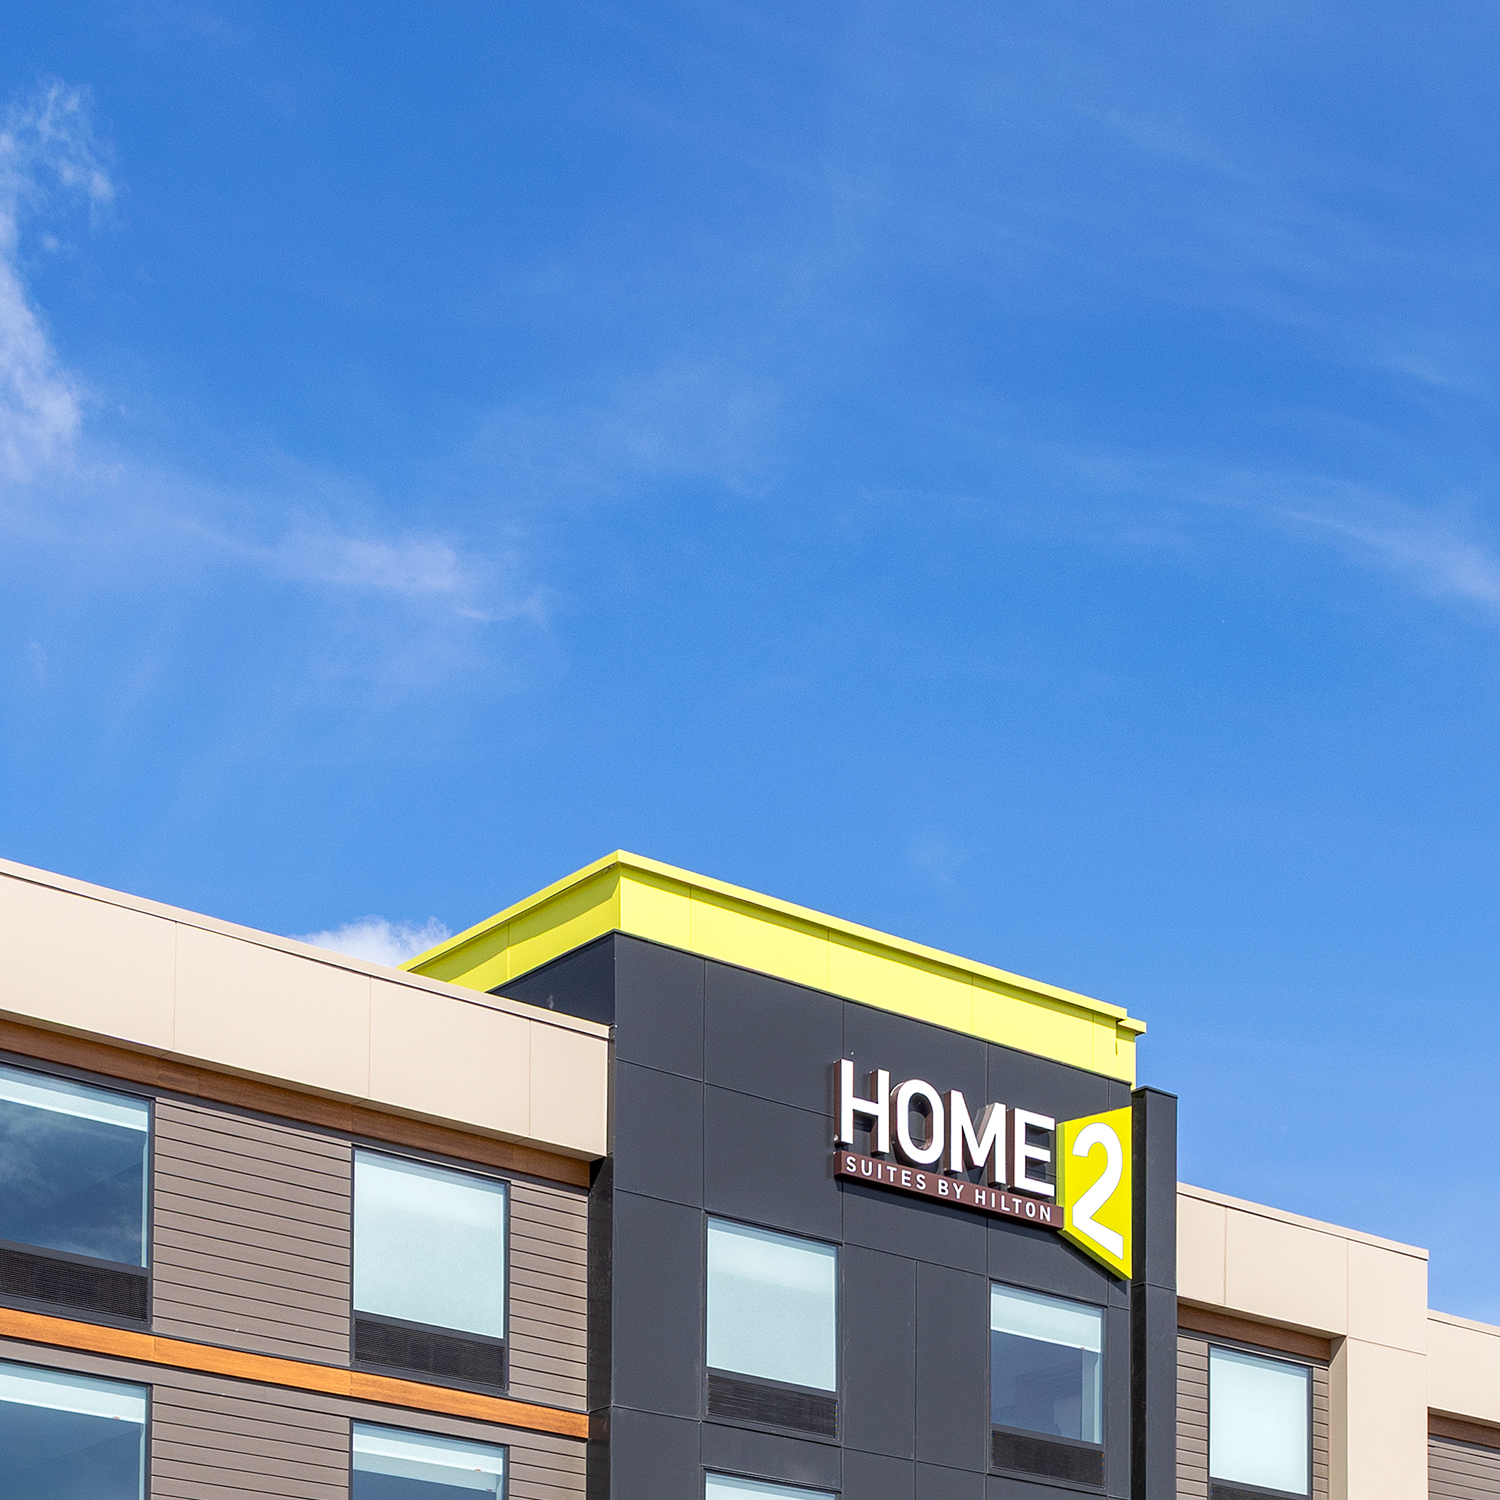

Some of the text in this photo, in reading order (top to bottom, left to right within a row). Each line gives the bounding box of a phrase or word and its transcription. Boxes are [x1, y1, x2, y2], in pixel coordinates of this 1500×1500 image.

[835, 1058, 1124, 1260] HOME 2
[845, 1156, 1052, 1222] SUITES BY HILTON
